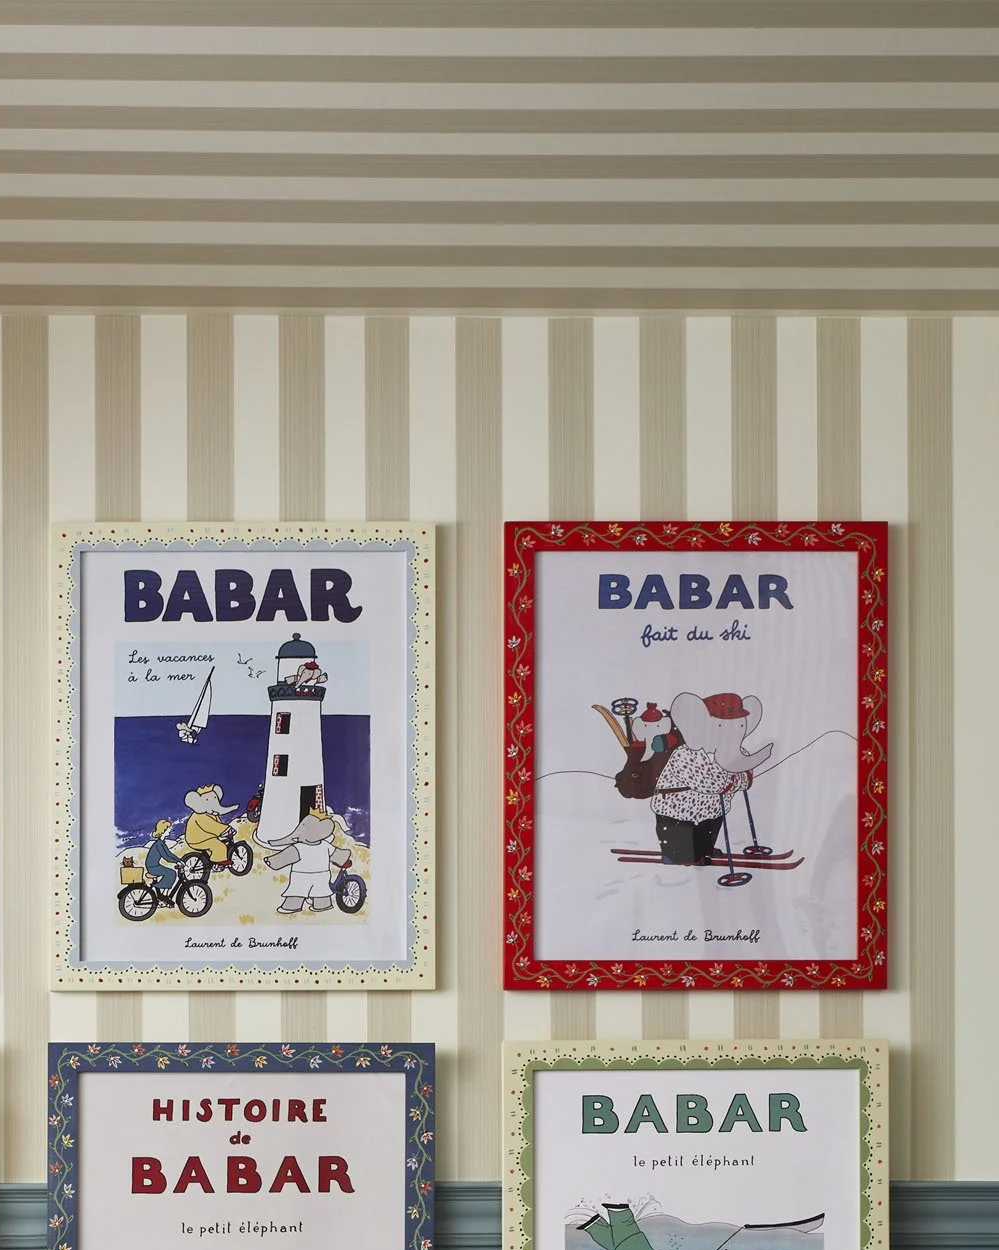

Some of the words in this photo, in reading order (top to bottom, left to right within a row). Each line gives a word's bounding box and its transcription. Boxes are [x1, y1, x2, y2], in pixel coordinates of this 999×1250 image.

[123, 567, 364, 624] BABAR
[597, 573, 795, 611] BABAR
[640, 623, 679, 649] fait
[686, 625, 714, 642] du
[718, 618, 752, 641] ski
[128, 649, 150, 665] Les
[156, 654, 215, 663] vacances
[127, 671, 139, 683] à
[144, 668, 161, 682] la
[166, 673, 196, 681] mer
[184, 936, 227, 949] Laurent
[230, 937, 243, 948] de
[248, 936, 299, 950] Brunhoff
[631, 928, 679, 942] Laurent
[683, 929, 699, 942] de
[703, 929, 761, 944] Brunhoff
[152, 1097, 328, 1124] HISTOIRE
[581, 1092, 809, 1135] BABAR
[228, 1130, 252, 1146] de
[633, 1155, 646, 1168] le
[651, 1155, 684, 1171] petit
[691, 1154, 755, 1171] éléphant
[131, 1155, 356, 1195] BABAR
[181, 1222, 194, 1234] le
[199, 1221, 231, 1238] petit
[238, 1220, 303, 1238] éléphant
